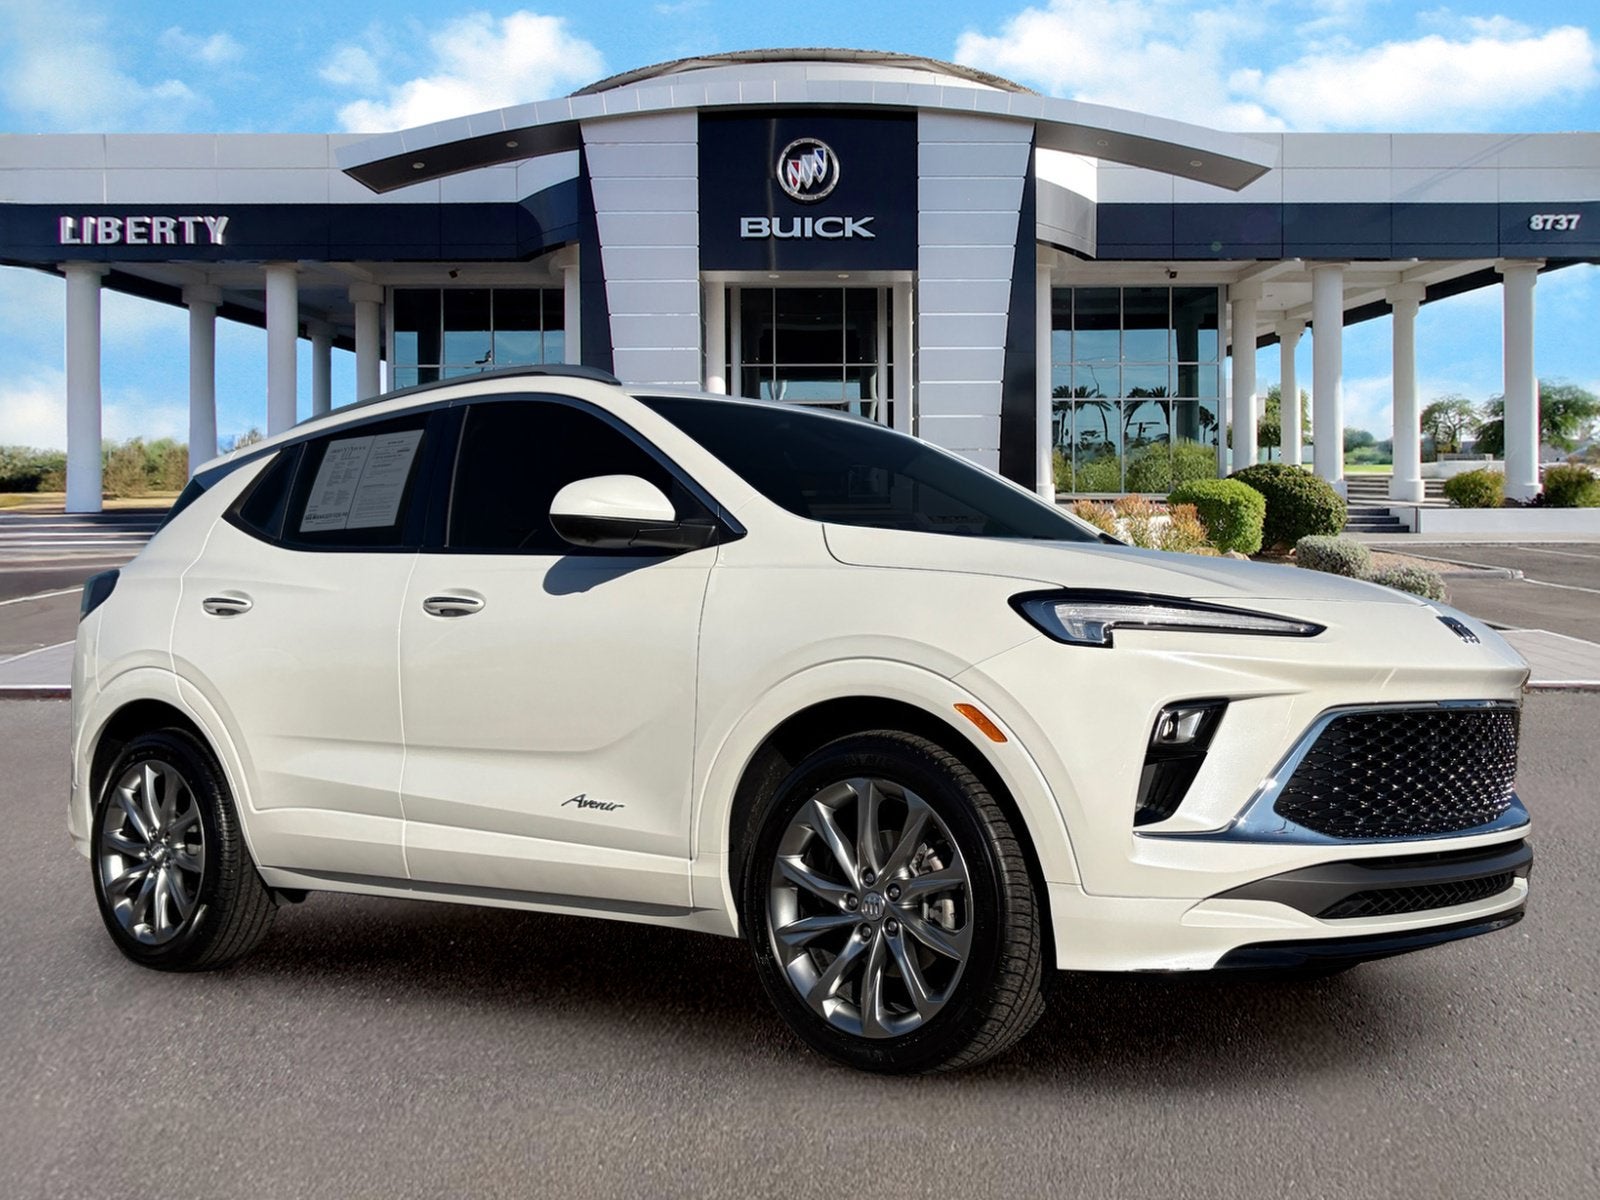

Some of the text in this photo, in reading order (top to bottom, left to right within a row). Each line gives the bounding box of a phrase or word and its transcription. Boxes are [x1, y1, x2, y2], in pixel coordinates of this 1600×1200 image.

[59, 216, 229, 245] LIBERTY
[740, 216, 876, 238] BUICK
[1529, 214, 1581, 231] 8737
[561, 793, 625, 811] Avenir
